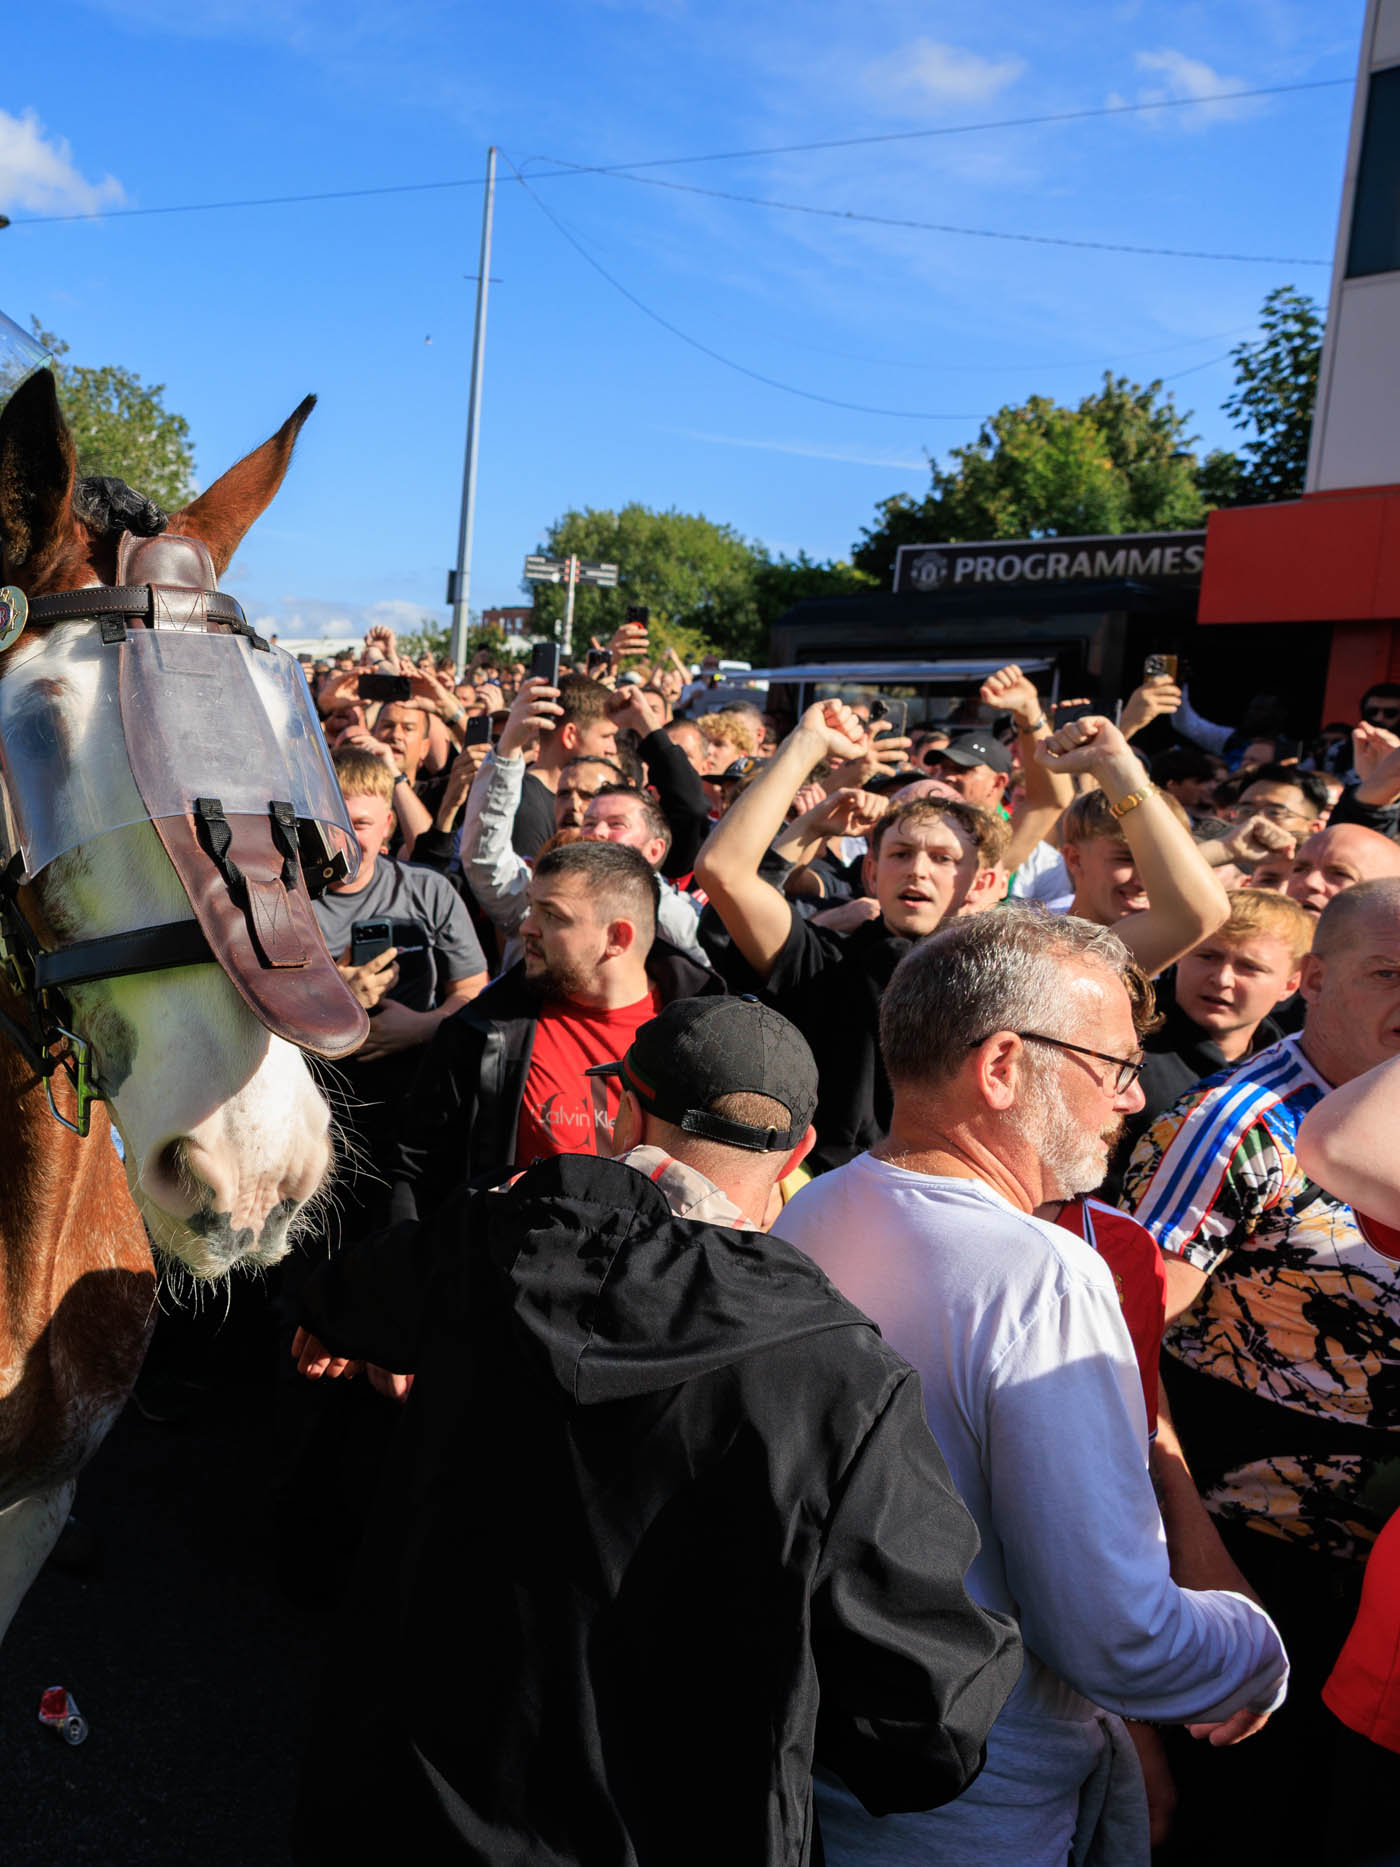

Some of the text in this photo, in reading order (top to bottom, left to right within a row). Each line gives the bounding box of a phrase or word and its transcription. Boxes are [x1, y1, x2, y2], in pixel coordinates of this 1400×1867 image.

[954, 545, 1204, 583] PROGRAMMES
[530, 1103, 616, 1129] Calvin Kle
